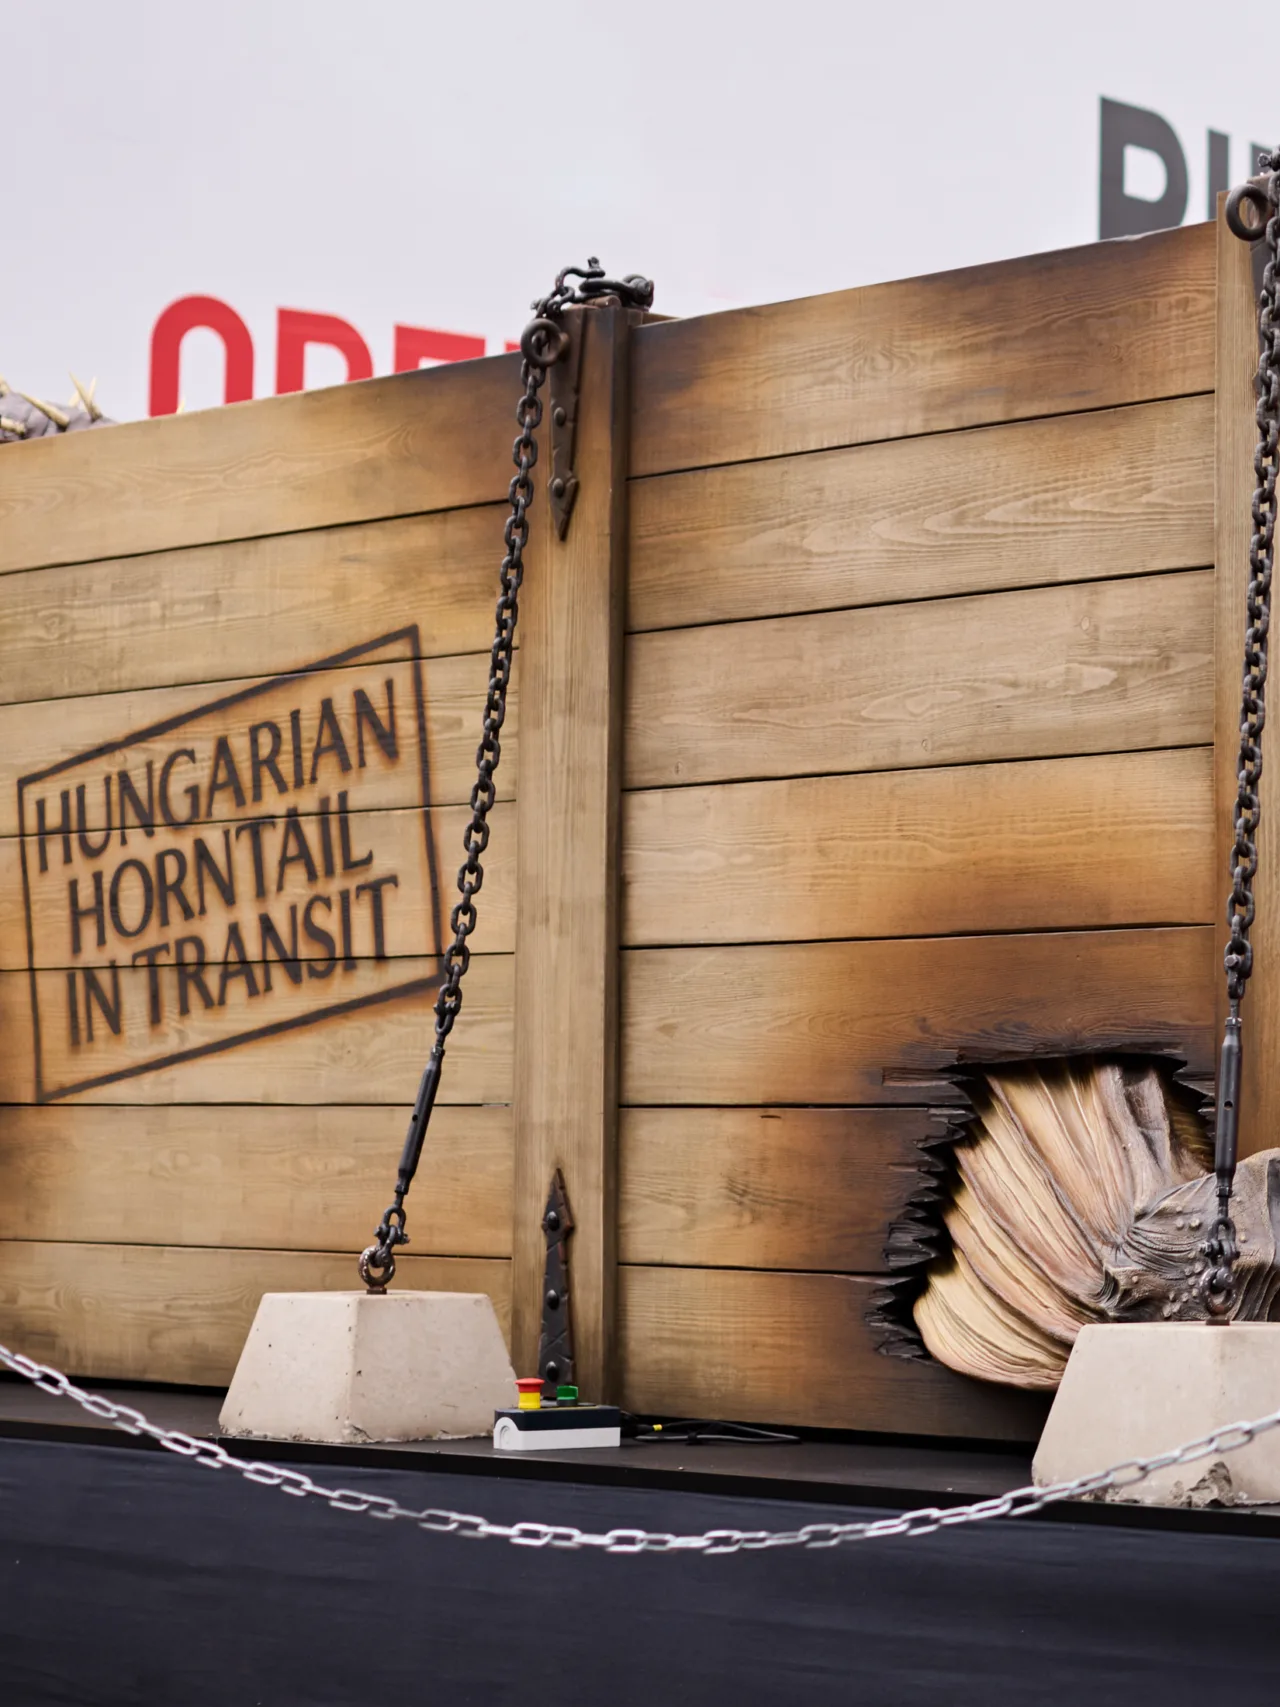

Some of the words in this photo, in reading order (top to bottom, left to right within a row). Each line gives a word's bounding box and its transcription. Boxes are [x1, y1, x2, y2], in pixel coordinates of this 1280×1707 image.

[34, 677, 399, 873] HUNGARIAN
[67, 790, 374, 956] HORNTAIL
[66, 959, 122, 1047] IN
[131, 874, 399, 1025] TRANSIT
